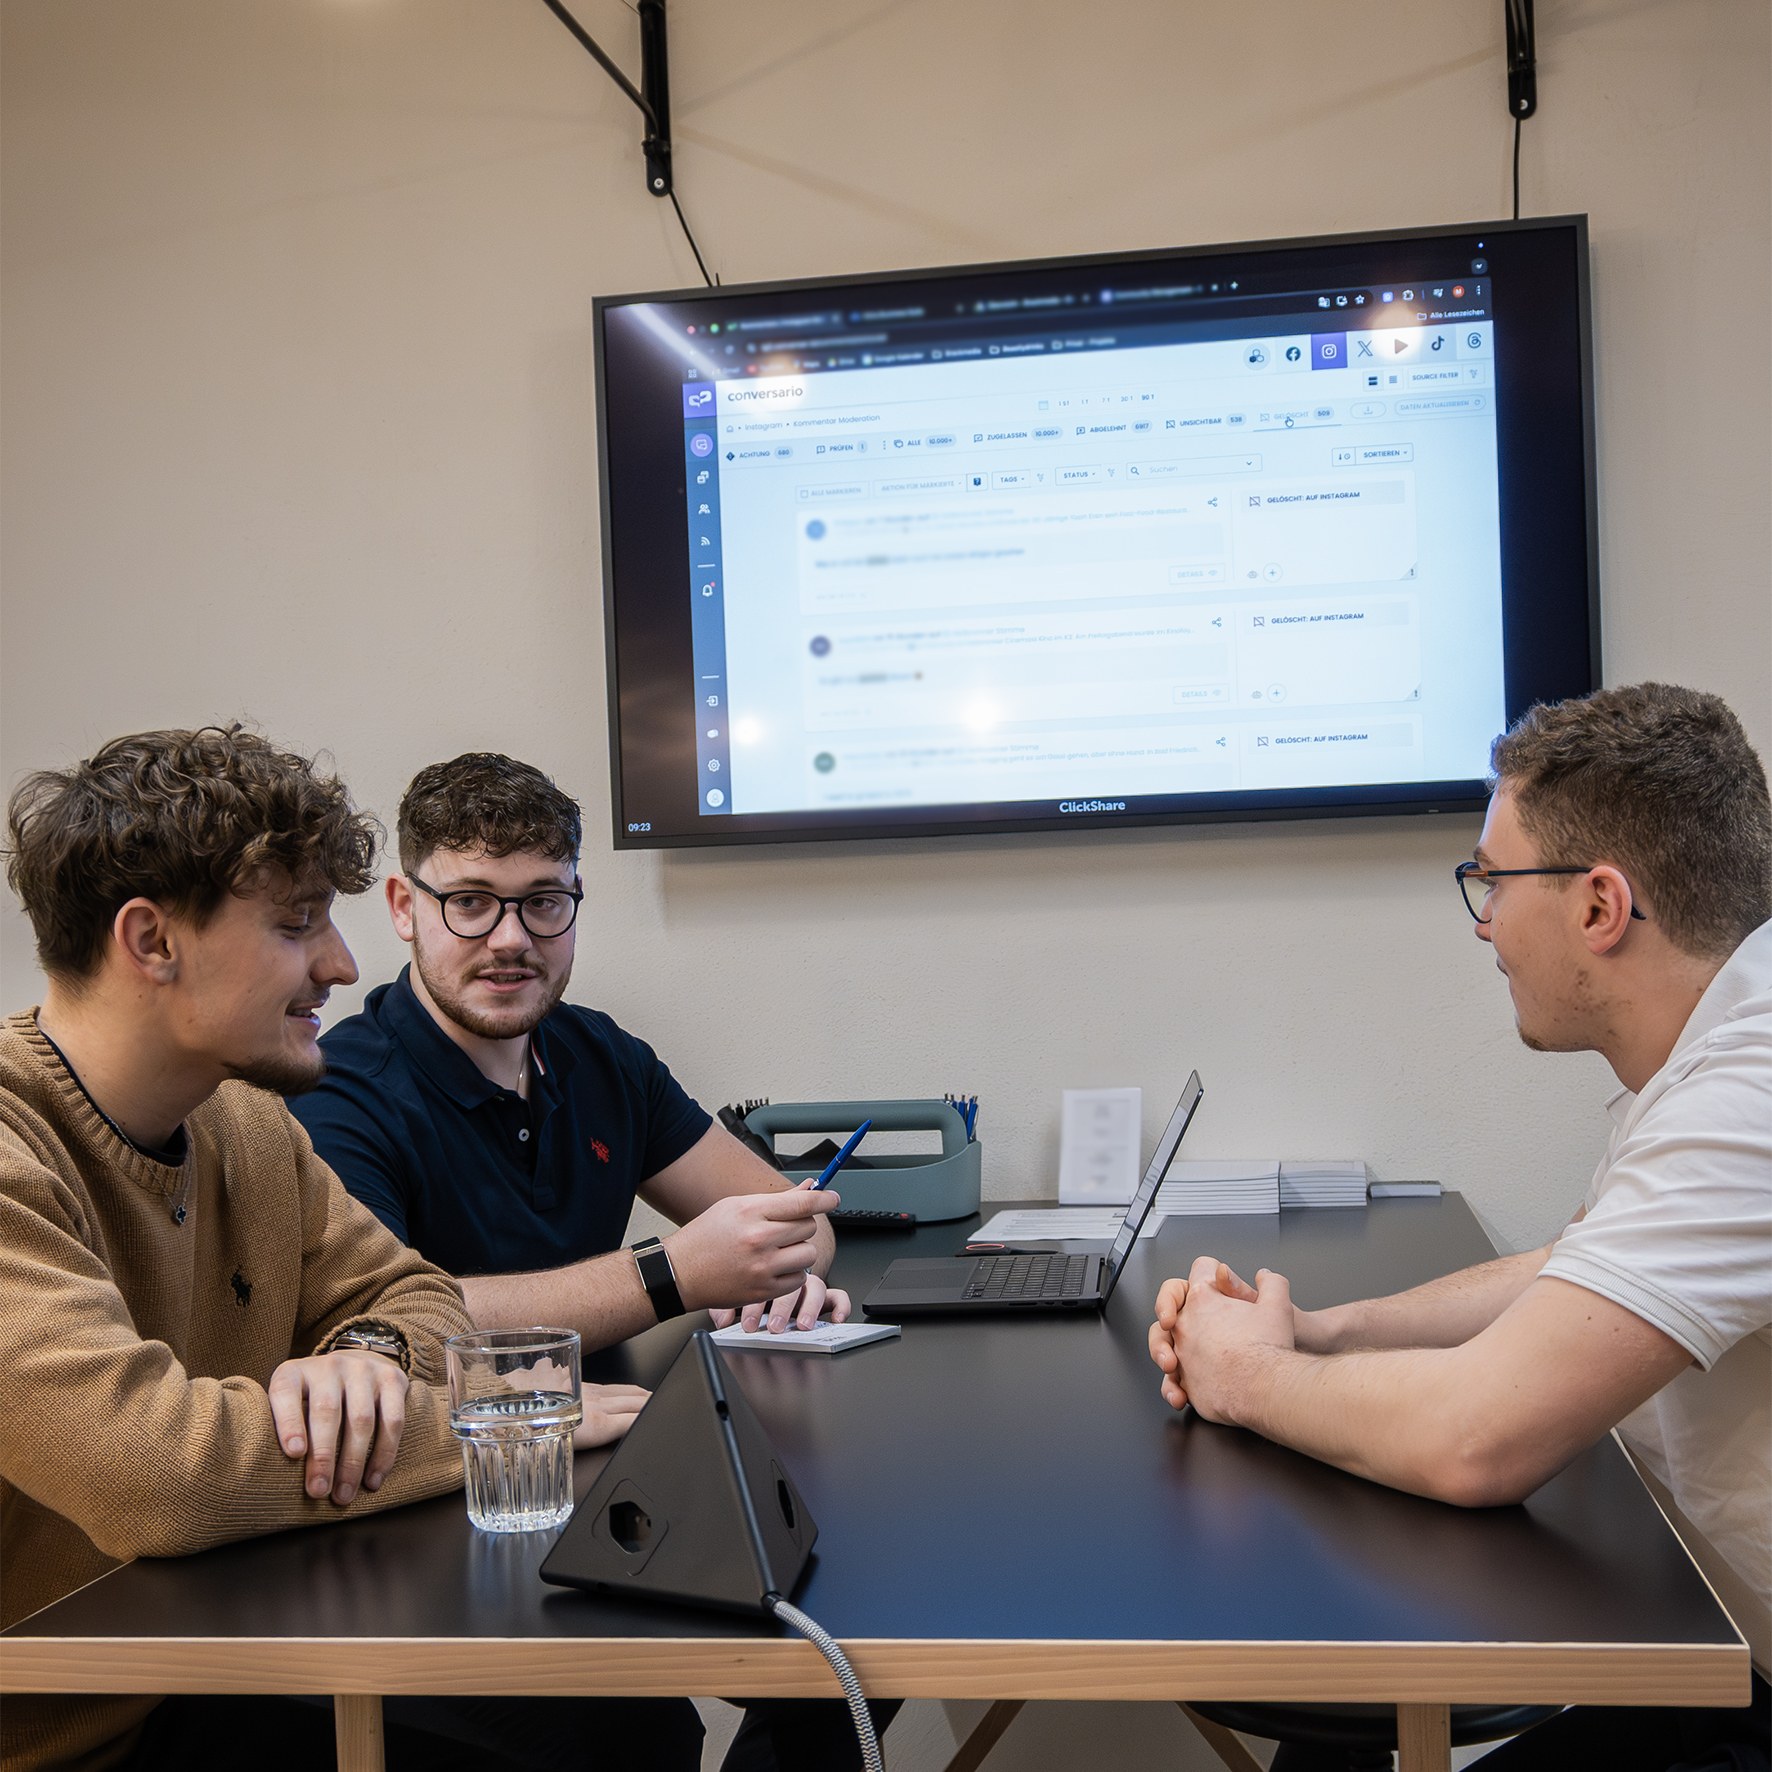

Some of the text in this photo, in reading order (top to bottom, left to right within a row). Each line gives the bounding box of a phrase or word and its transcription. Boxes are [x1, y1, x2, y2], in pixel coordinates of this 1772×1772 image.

[1444, 308, 1485, 318] Lesezeichen
[1412, 371, 1459, 381] SOURCE FILTER
[727, 386, 804, 402] conversario
[1400, 403, 1421, 411] DATEN
[793, 414, 880, 427] Kommentar Moderation
[1180, 417, 1222, 427] UNSICHTBAR
[744, 422, 783, 432] Instagram
[1090, 424, 1127, 434] ABGELEHNT
[987, 432, 1027, 441] ZUGELASSEN
[829, 443, 854, 452] PRÜFEN
[738, 450, 771, 459] ACHTUNG
[1364, 449, 1400, 459] SORTIEREN
[1149, 465, 1178, 474] Suchen
[1063, 471, 1089, 480] STATUS
[1267, 491, 1360, 504] GELÖSCHT: AUF INSTAGRAM
[1271, 612, 1364, 624] GELÖSCHT: AUF INSTAGRAM
[1275, 733, 1368, 745] GELÖSCHT: AUF INSTAGRAM
[1058, 800, 1126, 814] ClickShare
[628, 822, 652, 832] 09:23
